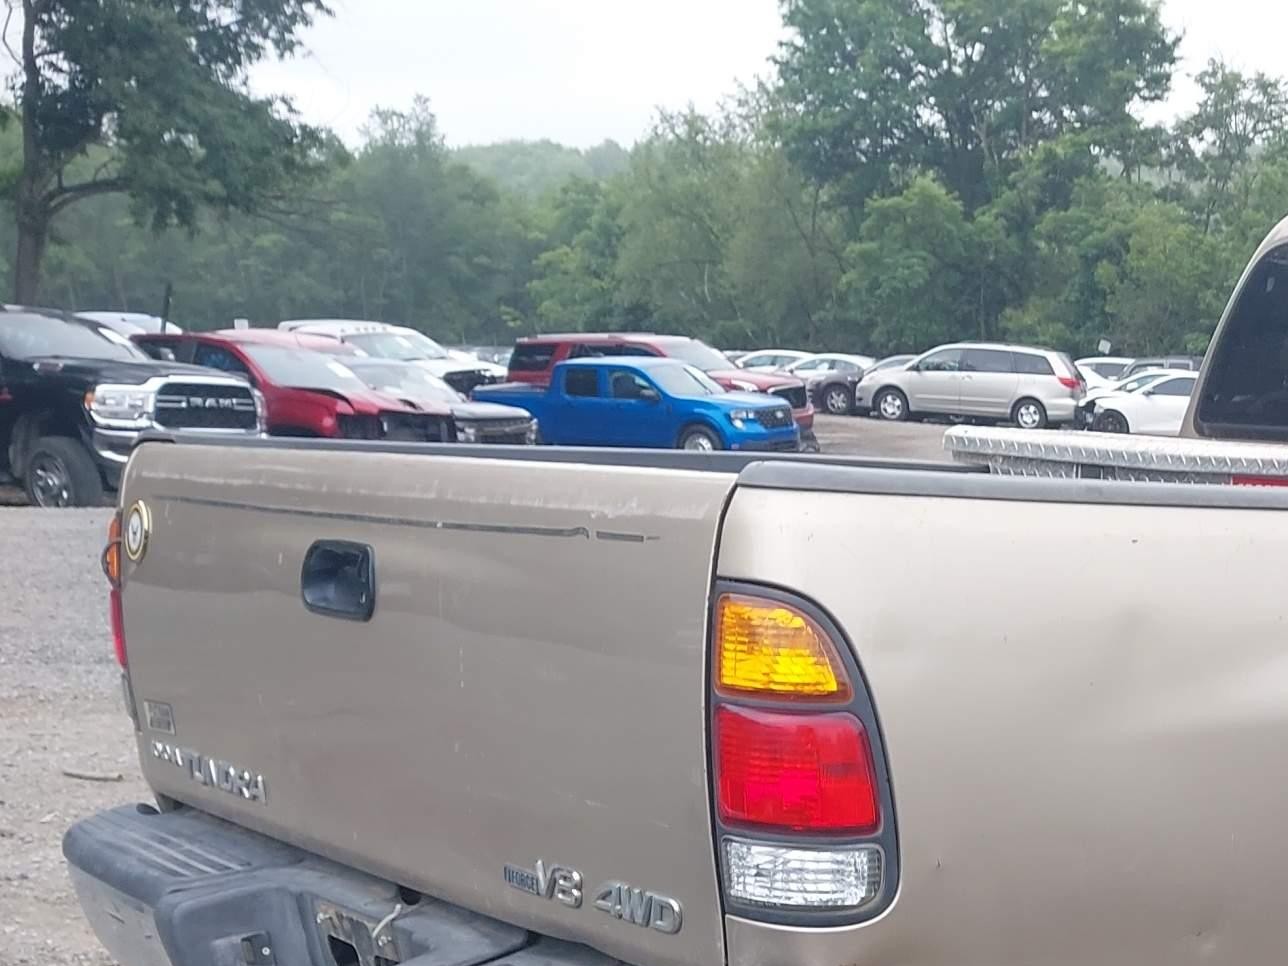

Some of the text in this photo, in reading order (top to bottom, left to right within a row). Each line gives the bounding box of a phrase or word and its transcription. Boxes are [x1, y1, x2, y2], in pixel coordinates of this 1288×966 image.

[189, 396, 233, 408] RAM
[536, 860, 584, 908] V8
[594, 881, 682, 935] 4WD
